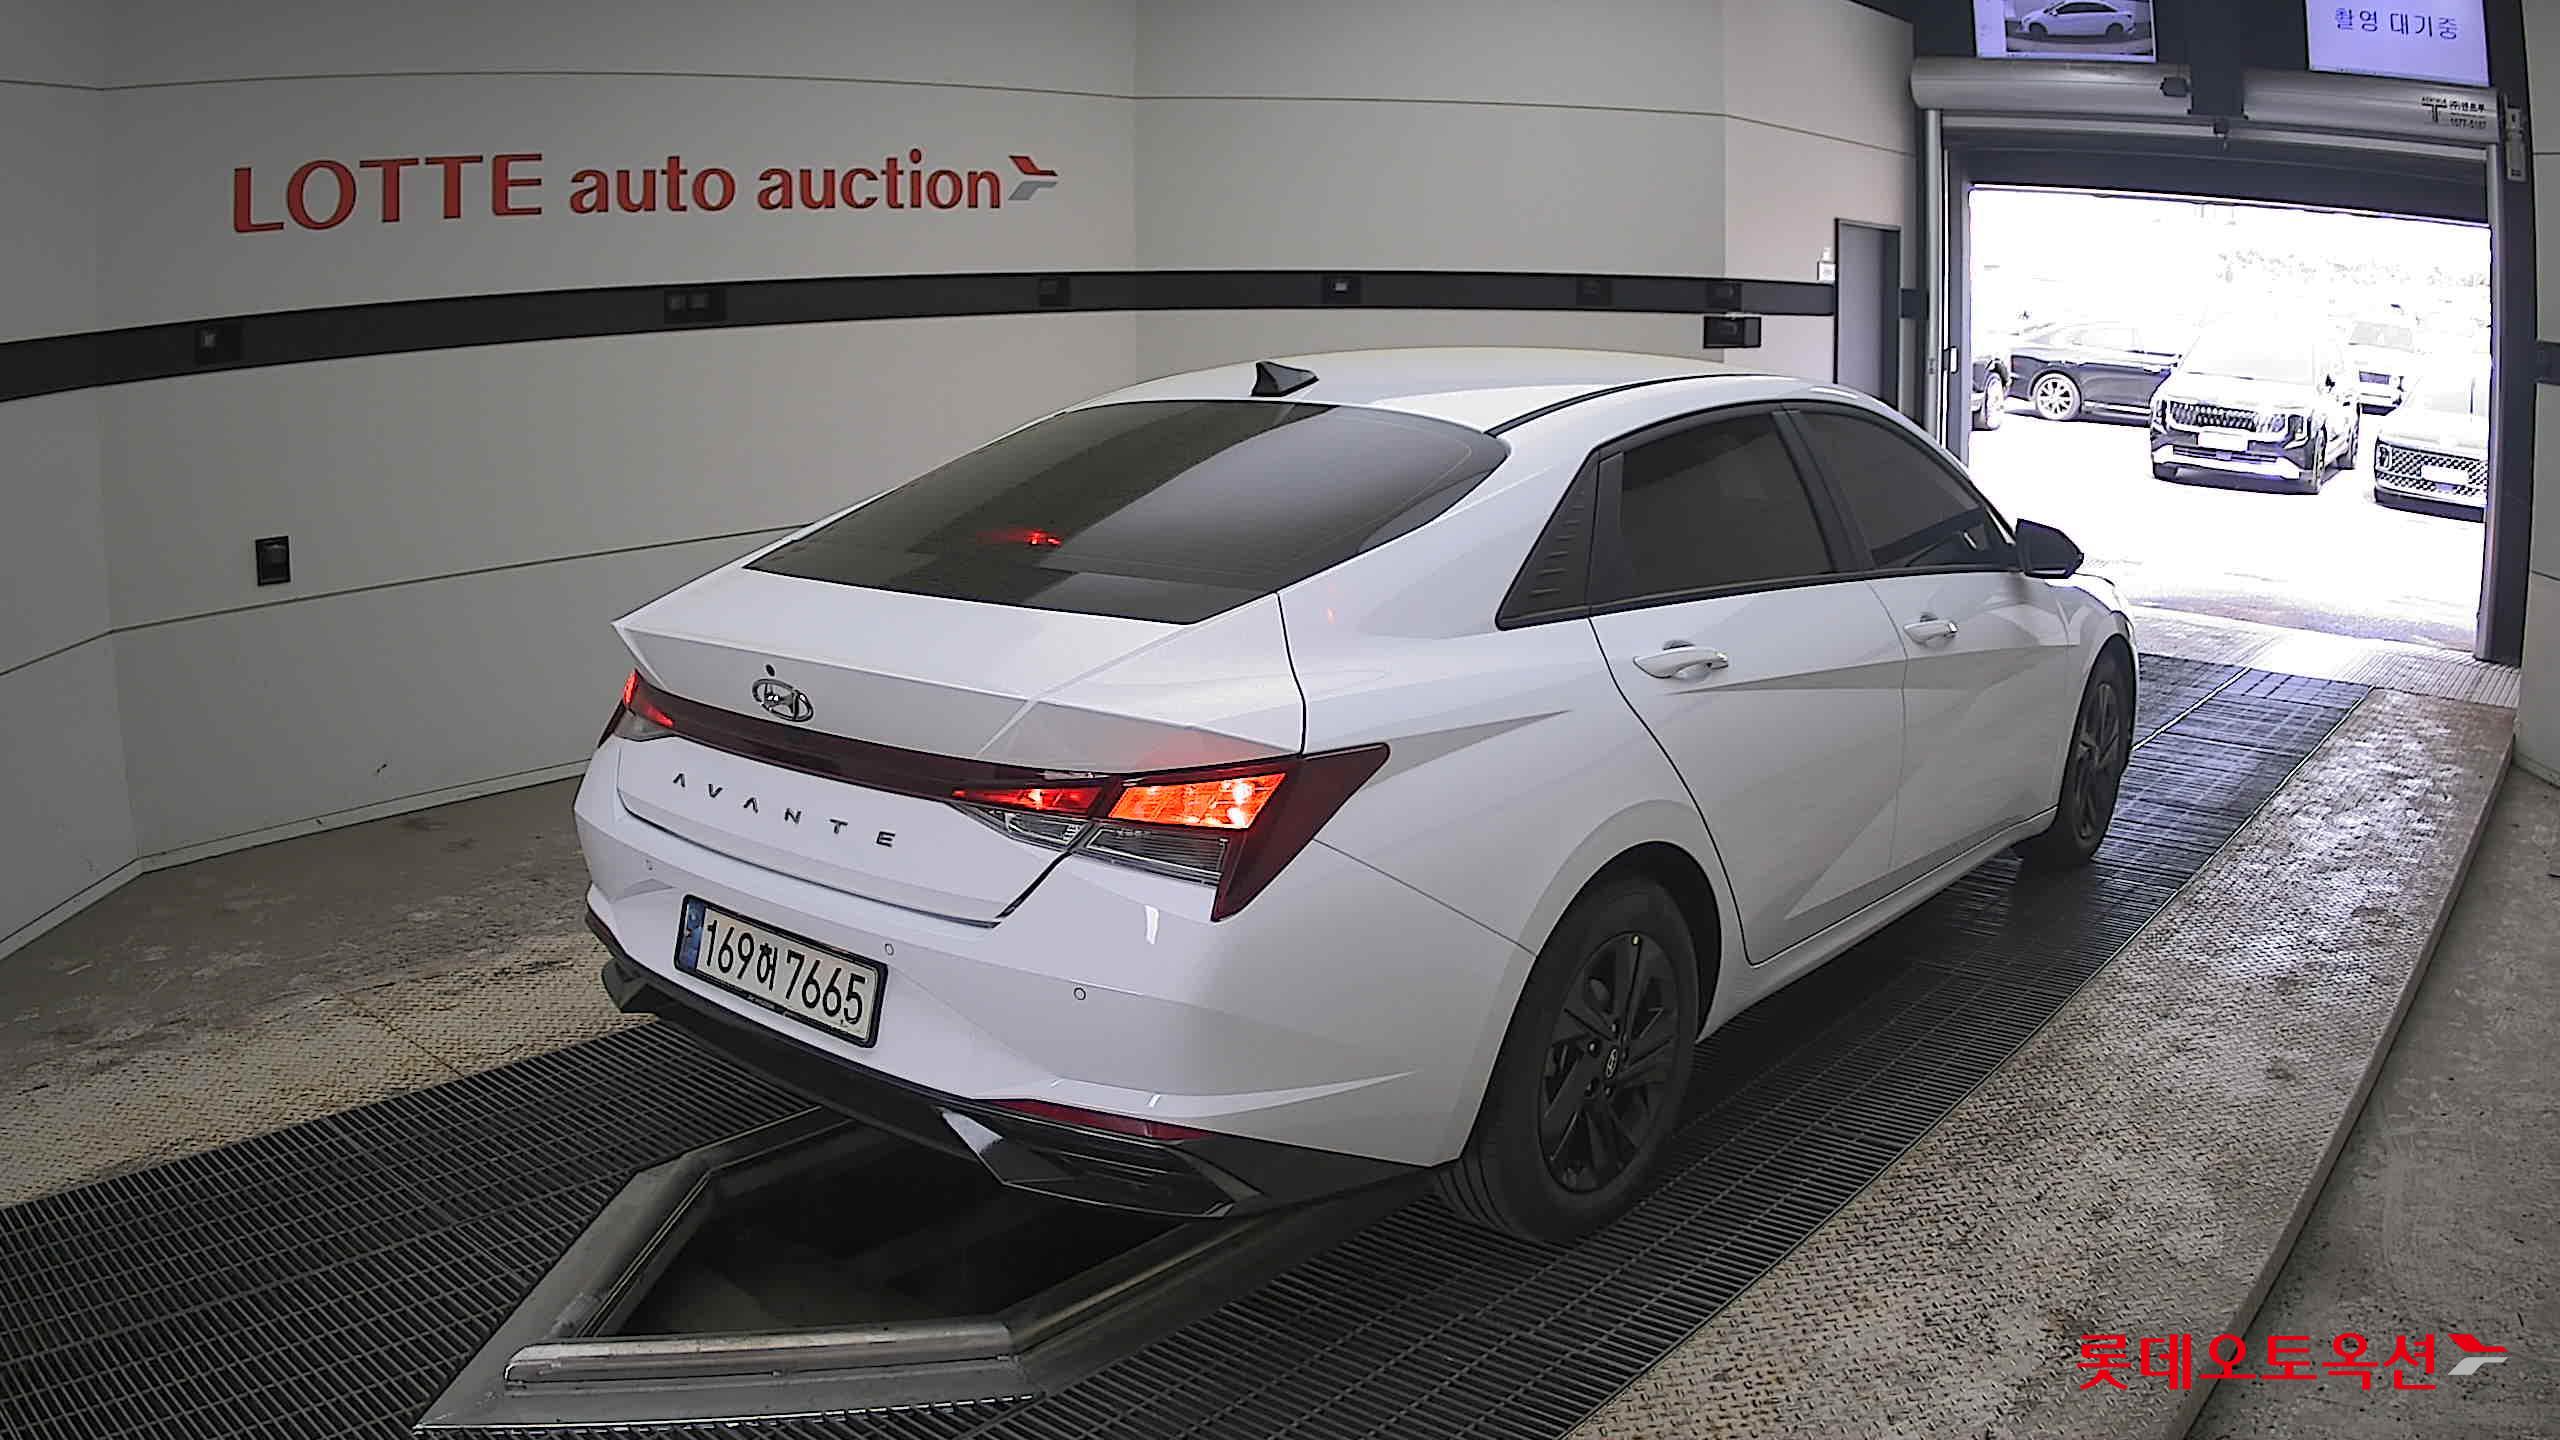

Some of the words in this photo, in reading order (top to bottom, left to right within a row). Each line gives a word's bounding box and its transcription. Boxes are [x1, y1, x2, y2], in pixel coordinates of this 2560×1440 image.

[234, 154, 543, 233] LOTTE
[570, 156, 737, 215] auto
[757, 149, 1001, 211] auction
[673, 771, 897, 848] AVANTE
